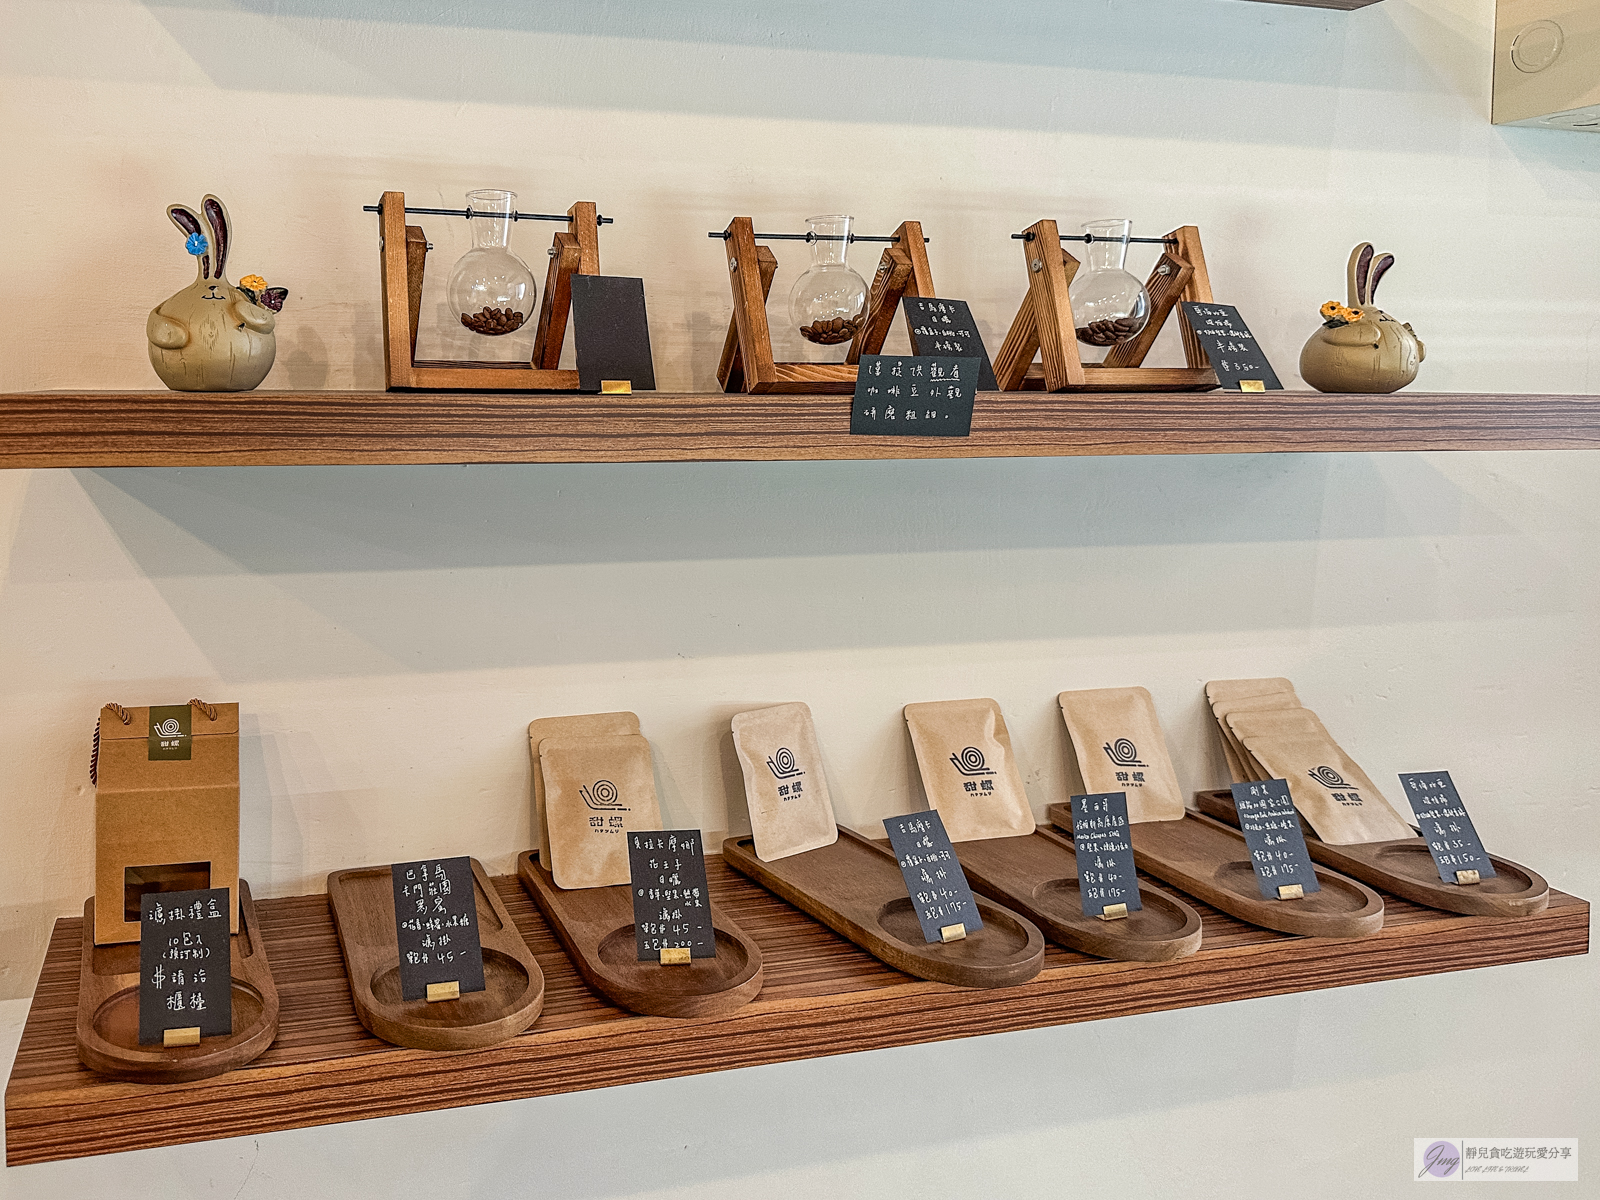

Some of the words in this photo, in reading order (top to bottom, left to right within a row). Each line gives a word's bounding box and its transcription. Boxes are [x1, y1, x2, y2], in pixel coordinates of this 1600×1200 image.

[406, 864, 446, 881] 巴拿馬
[148, 898, 222, 925] 濾掛禮盒
